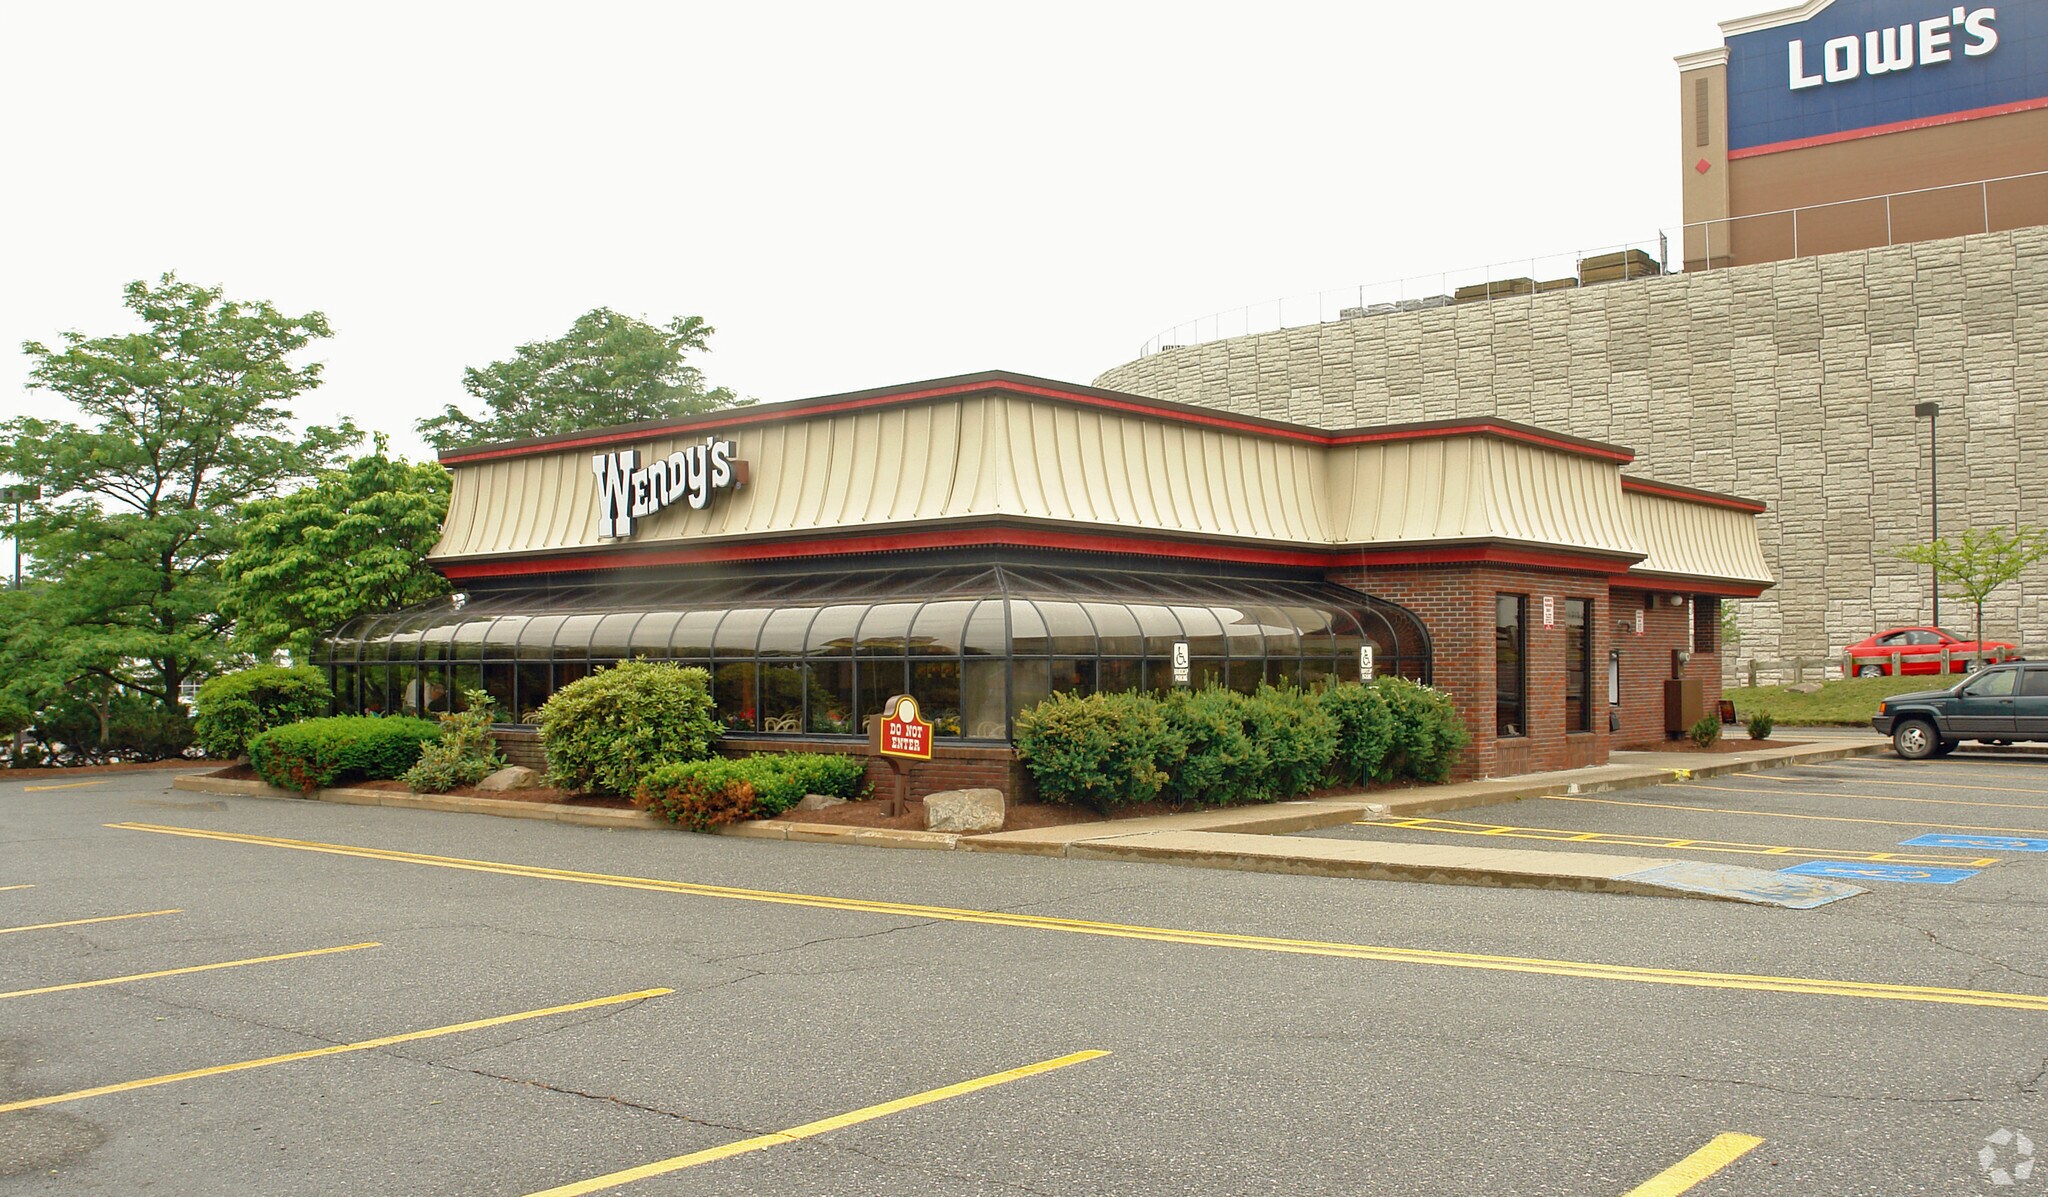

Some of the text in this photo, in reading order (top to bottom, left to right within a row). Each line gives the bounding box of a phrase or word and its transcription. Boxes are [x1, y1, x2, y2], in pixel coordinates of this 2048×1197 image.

[1789, 6, 1998, 90] LOWE'S
[890, 723, 922, 738] DO NOT
[891, 736, 920, 751] ENTER
